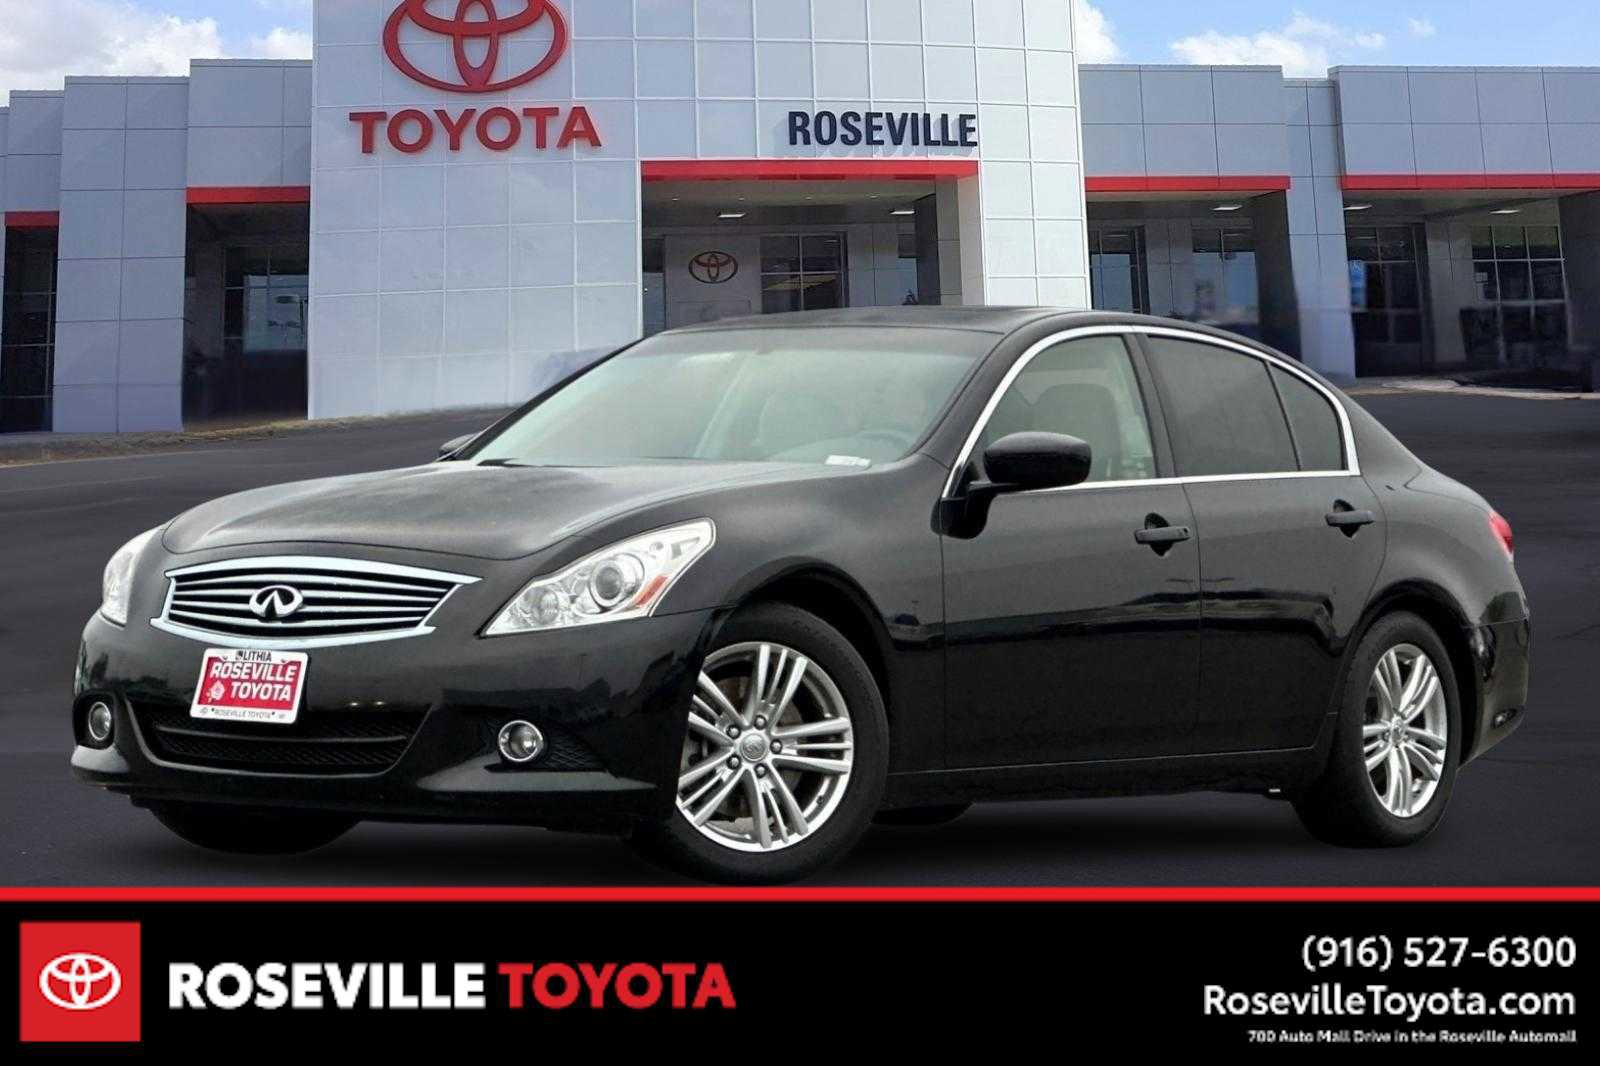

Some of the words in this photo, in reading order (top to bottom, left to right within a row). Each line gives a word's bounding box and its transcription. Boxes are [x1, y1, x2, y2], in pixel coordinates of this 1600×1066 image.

[350, 106, 602, 154] TOYOTA
[789, 111, 978, 147] ROSEVILLE
[209, 661, 297, 683] ROSEVILLE
[230, 681, 291, 702] TOYOTA
